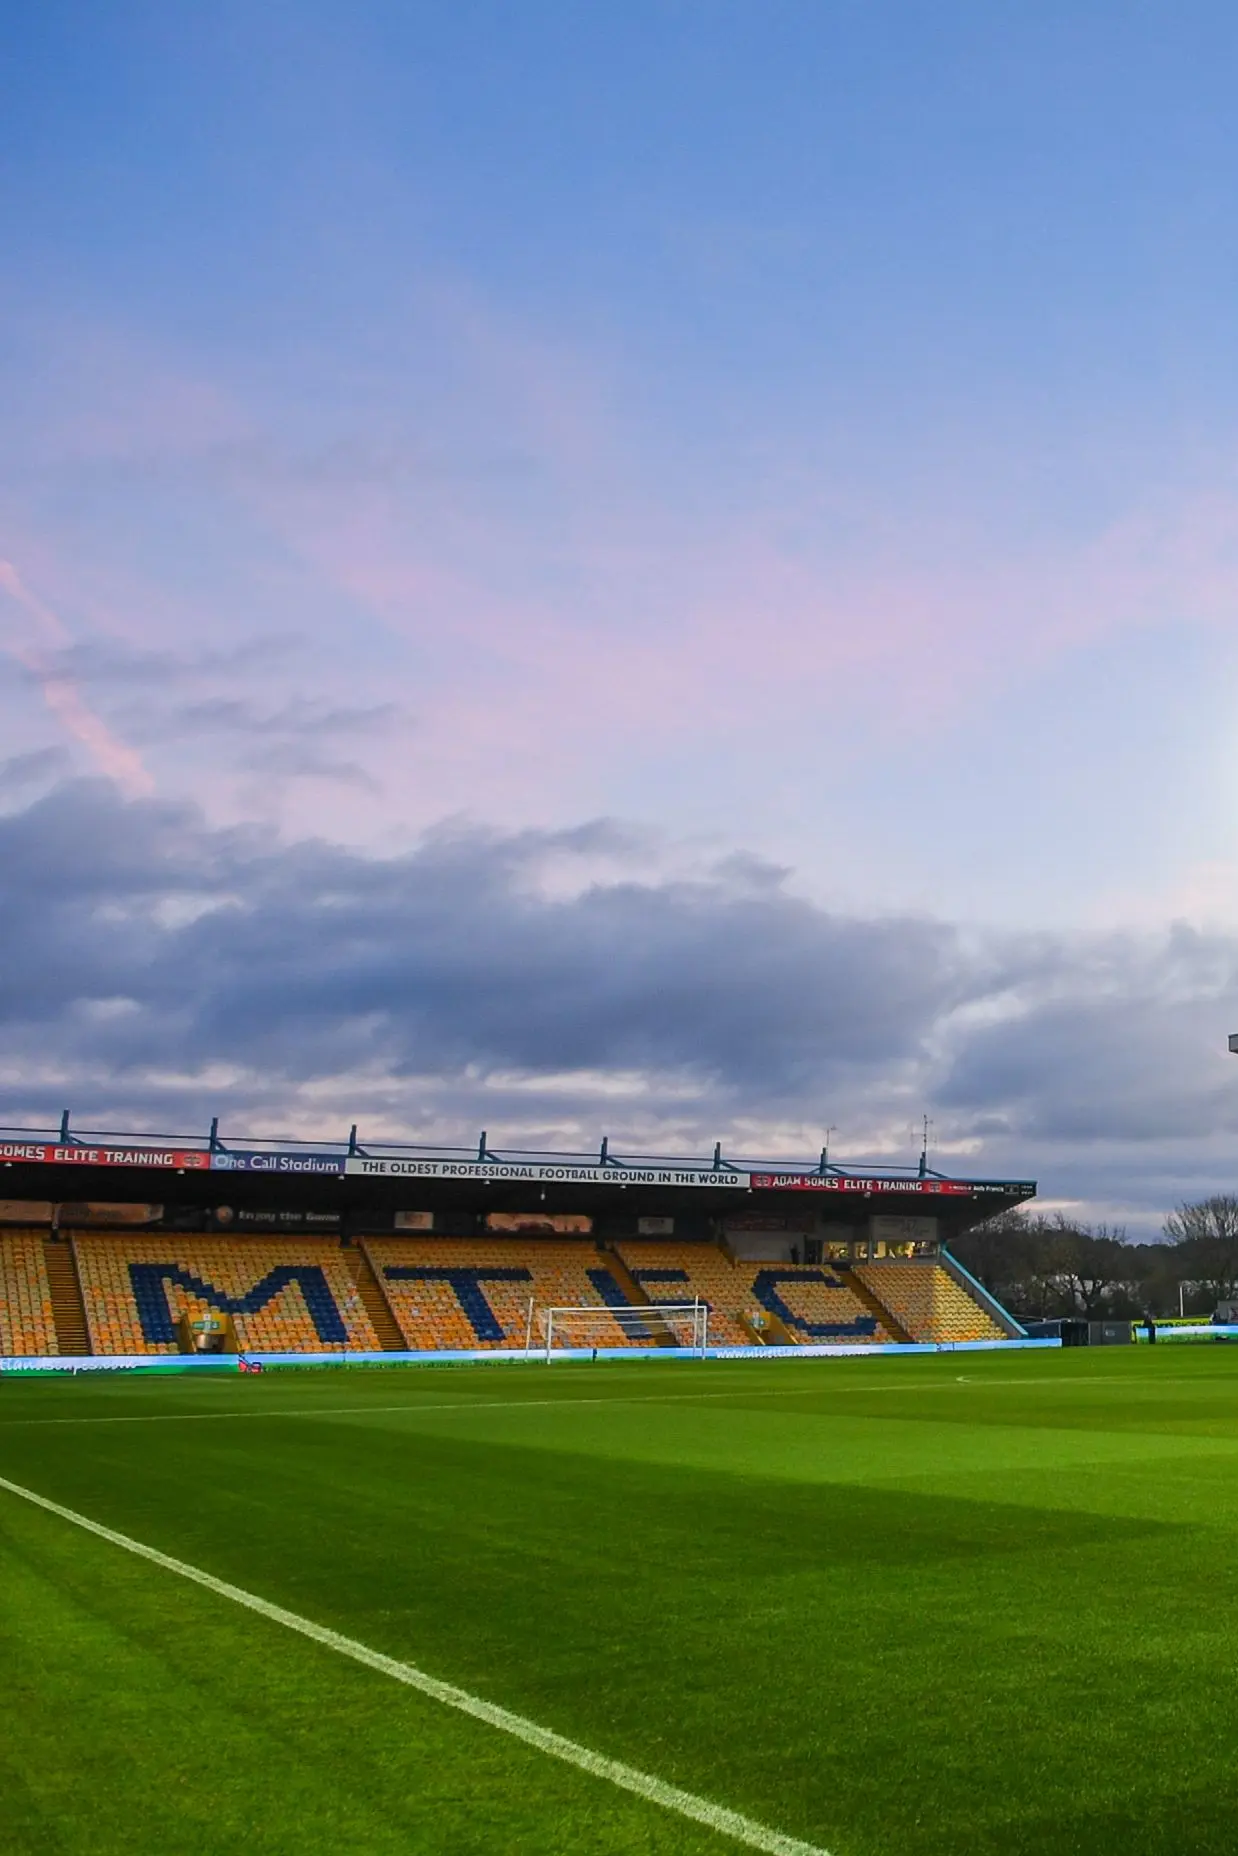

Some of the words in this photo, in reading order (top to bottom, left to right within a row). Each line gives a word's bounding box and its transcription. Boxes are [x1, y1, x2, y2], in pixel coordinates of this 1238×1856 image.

[54, 1149, 99, 1162] ELITE
[104, 1151, 173, 1165] TRAINING
[215, 1154, 245, 1168] One
[250, 1155, 276, 1169] Call
[280, 1157, 339, 1172] Stadium
[361, 1161, 386, 1173] THE
[390, 1163, 438, 1174] OLDEST
[442, 1165, 534, 1178] PROFESSIONAL
[539, 1168, 599, 1180] FOOTBALL
[602, 1171, 655, 1182] GROUND
[659, 1173, 671, 1182] IN
[675, 1173, 695, 1183] THE
[698, 1174, 738, 1185] WORLD
[772, 1176, 801, 1187] ADAM
[804, 1177, 839, 1189] SOMES
[843, 1179, 873, 1190] ELITE
[876, 1181, 922, 1191] TRAINING
[239, 1211, 276, 1222] Enjoy
[280, 1212, 302, 1221] the
